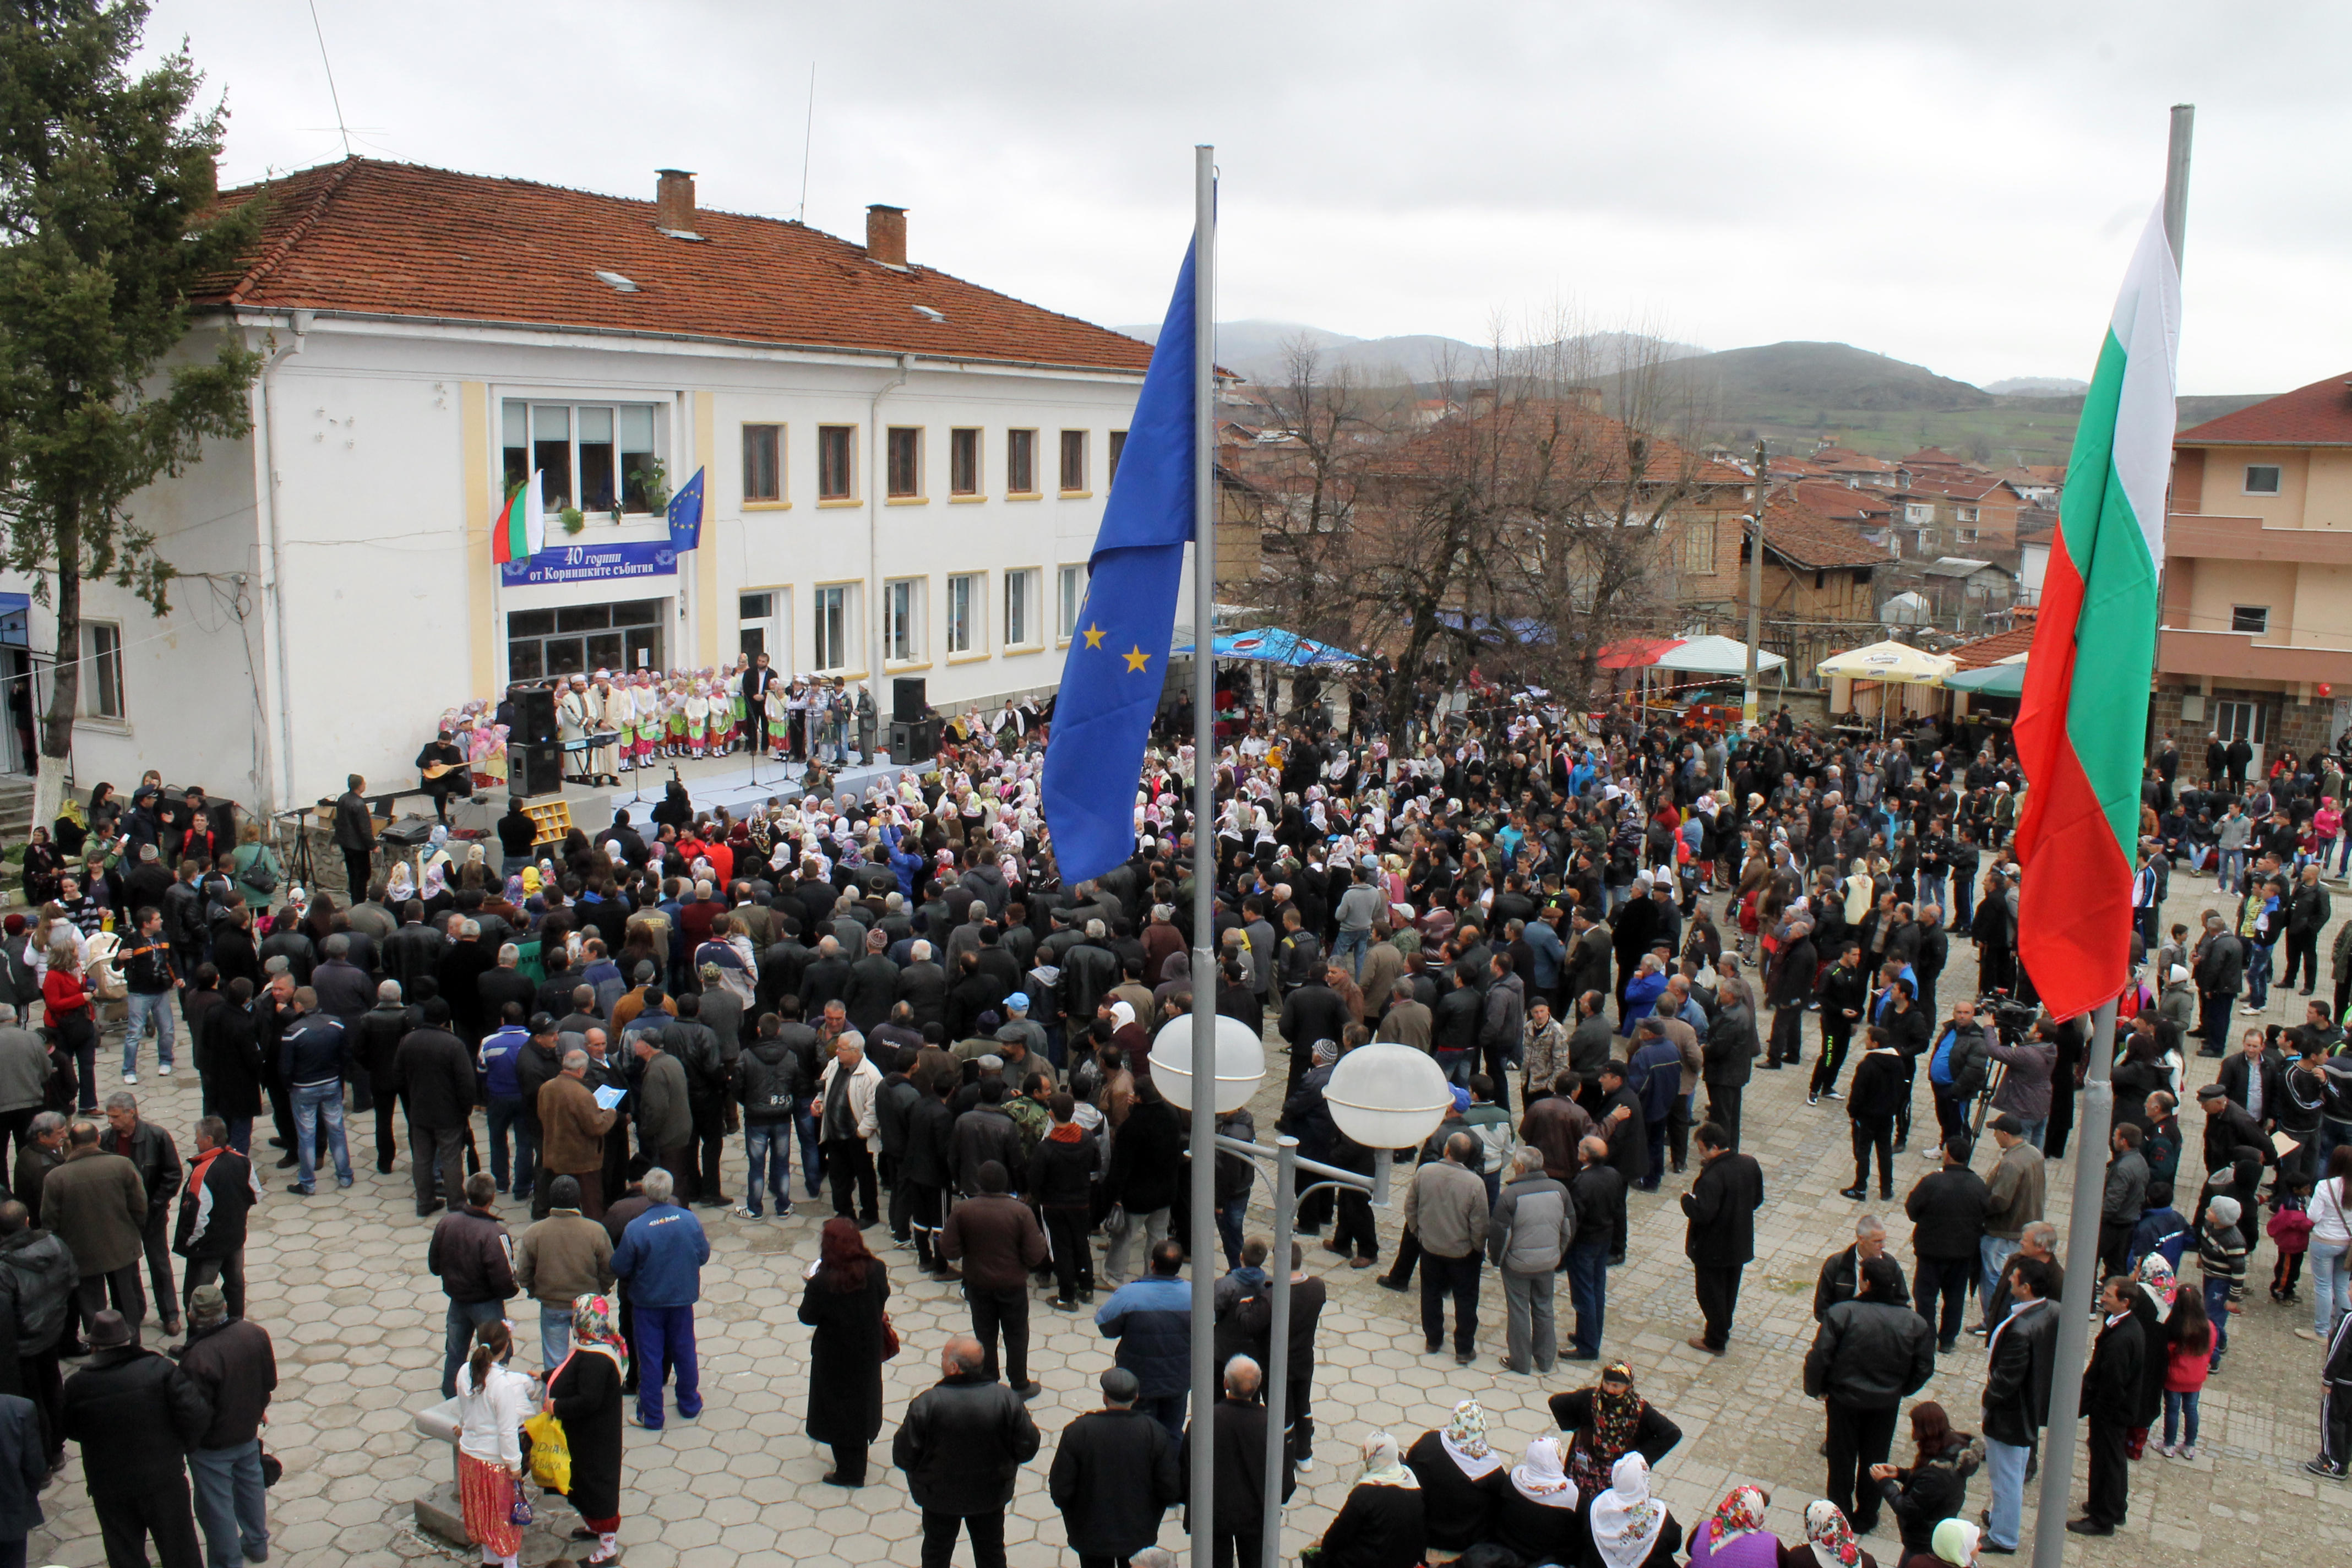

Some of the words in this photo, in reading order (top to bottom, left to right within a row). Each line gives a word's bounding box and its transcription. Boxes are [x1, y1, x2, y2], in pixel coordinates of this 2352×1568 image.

[564, 547, 584, 565] 40
[585, 553, 622, 567] години
[530, 571, 542, 581] от
[545, 566, 611, 582] Корнишките
[613, 563, 654, 575] събития
